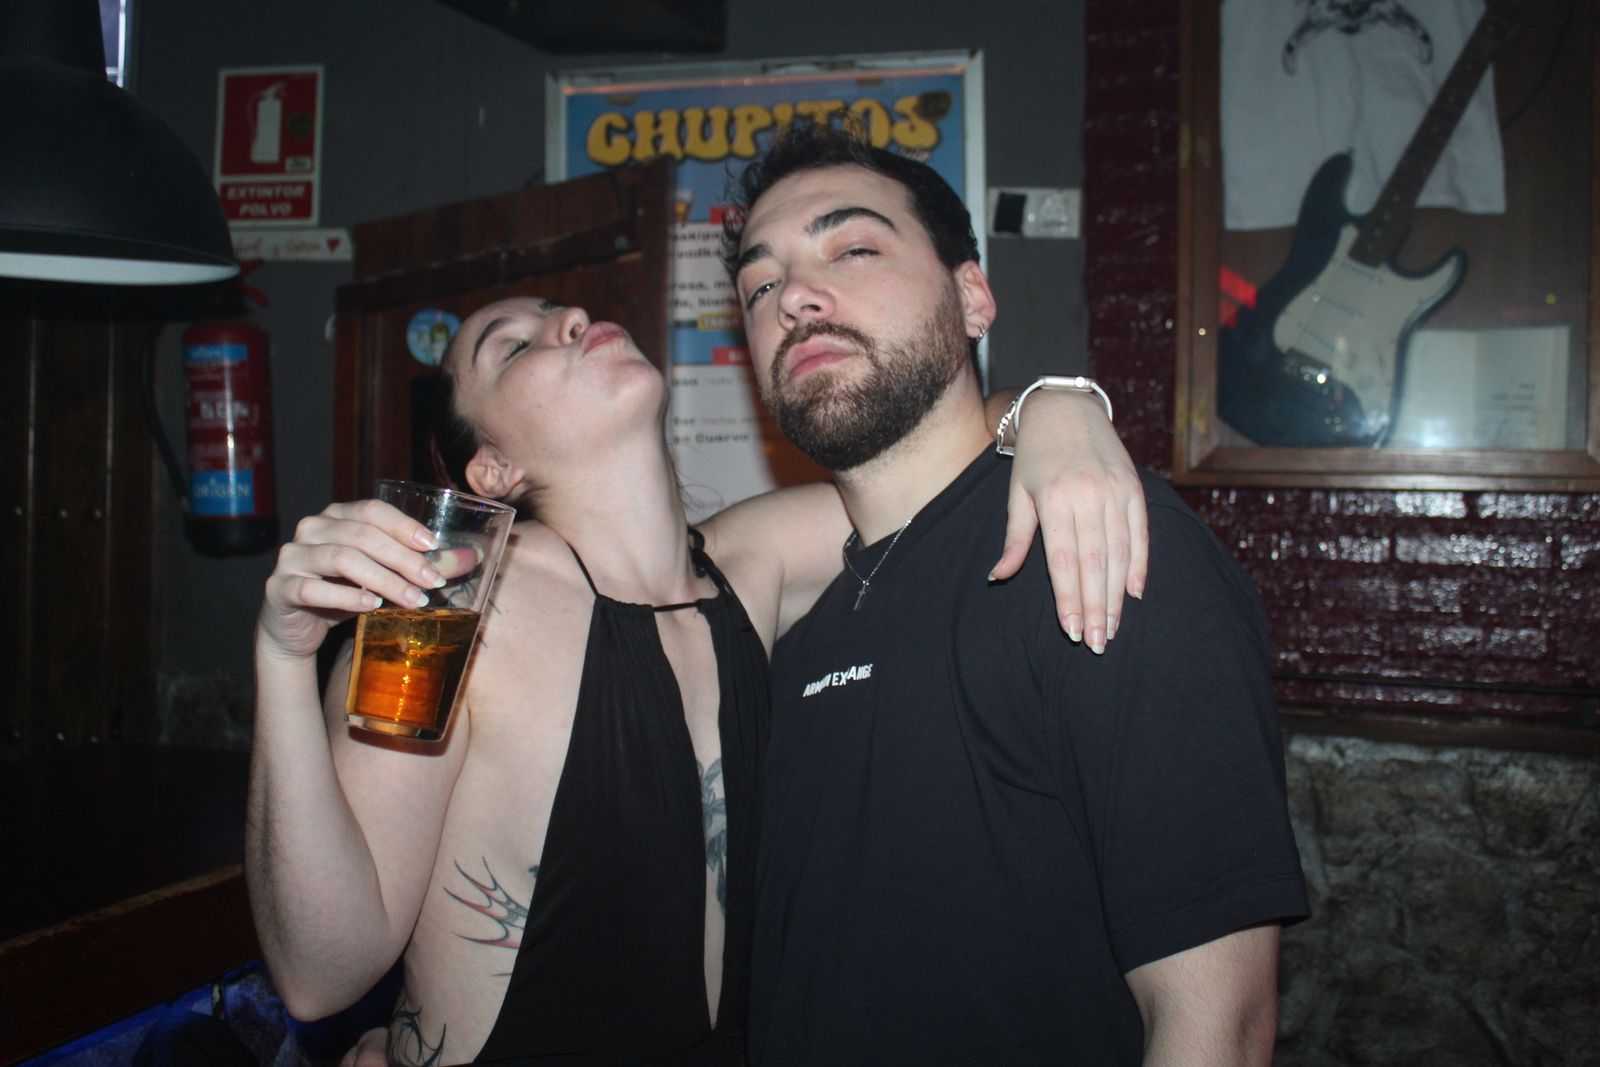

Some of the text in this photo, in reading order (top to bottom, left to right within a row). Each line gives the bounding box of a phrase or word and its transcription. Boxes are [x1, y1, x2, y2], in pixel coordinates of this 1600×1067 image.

[586, 96, 939, 165] CHUPITOS
[227, 185, 305, 199] EXTINTOR
[239, 202, 293, 216] POLVO
